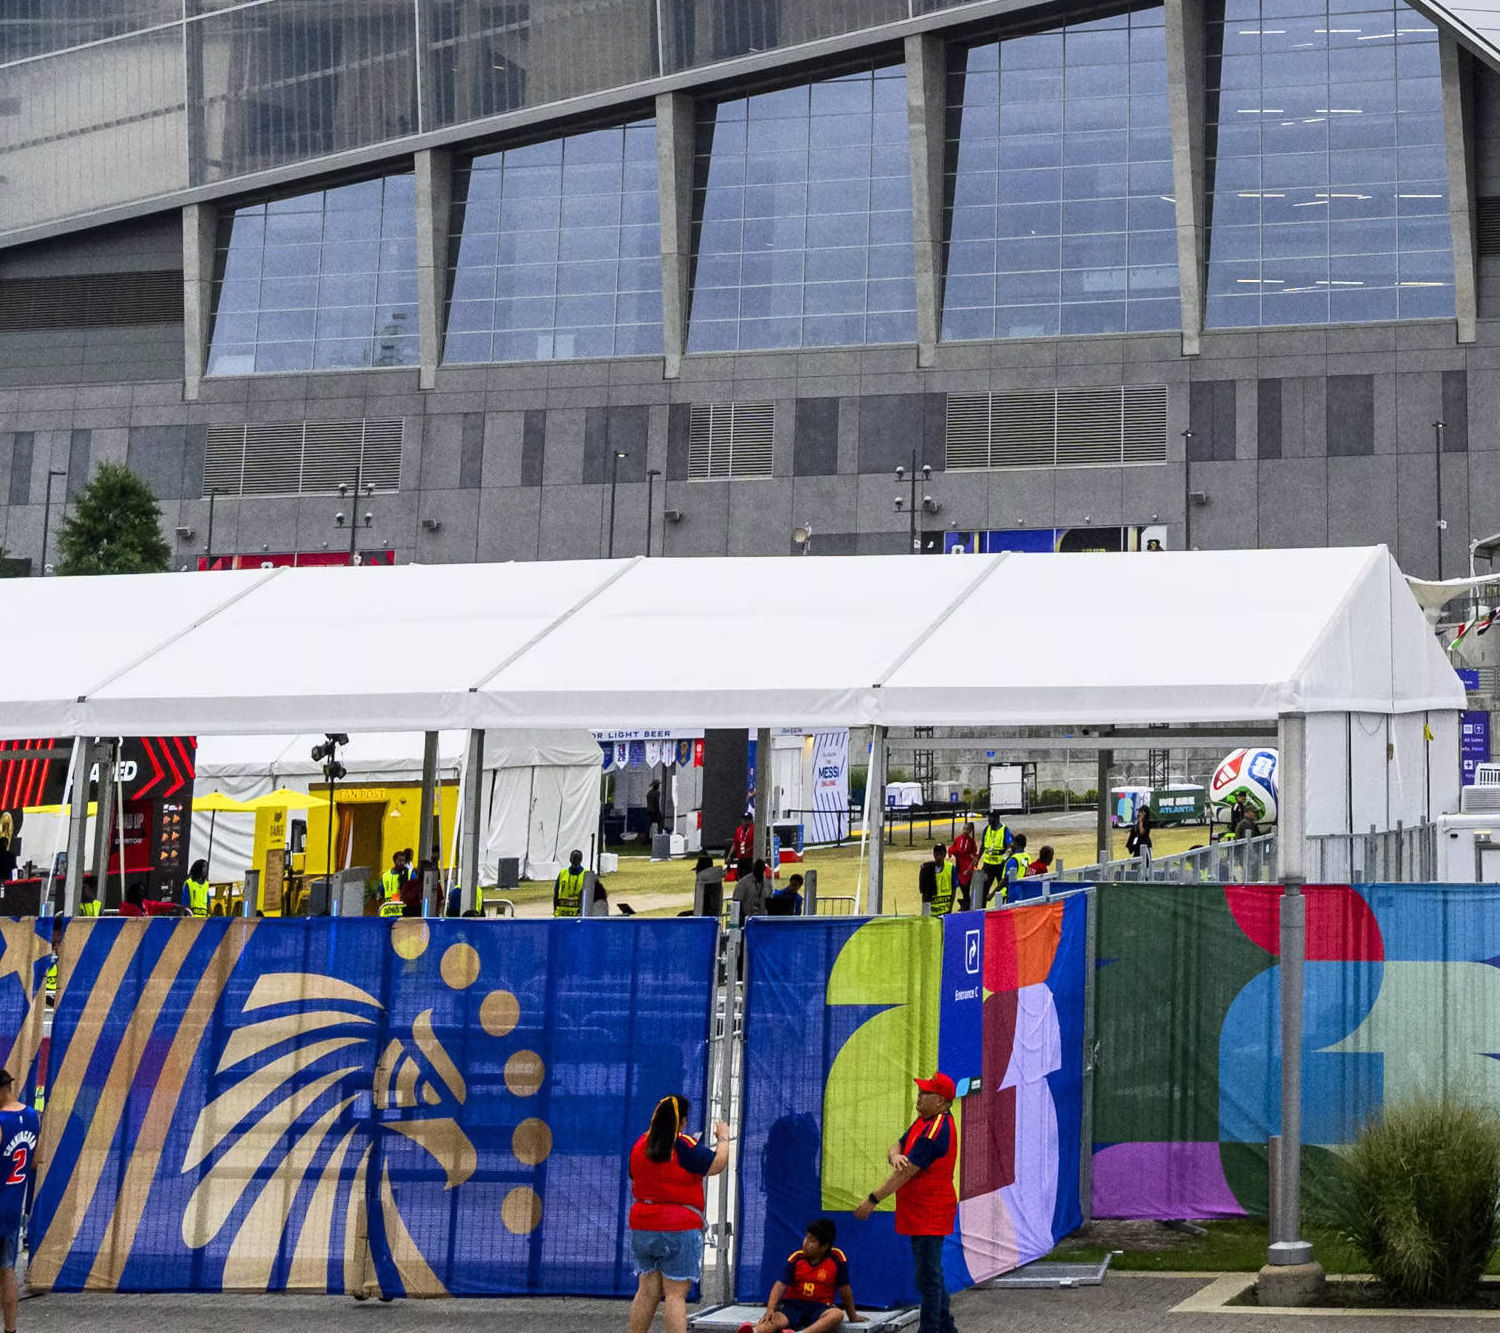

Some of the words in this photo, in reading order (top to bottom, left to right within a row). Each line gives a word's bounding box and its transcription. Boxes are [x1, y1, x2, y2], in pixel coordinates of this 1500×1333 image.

[608, 731, 639, 739] LIGHT
[644, 730, 671, 738] BEER
[818, 766, 840, 779] MESSI
[955, 988, 974, 1002] Entrance
[4, 1148, 27, 1186] 2
[804, 1282, 815, 1296] 19
